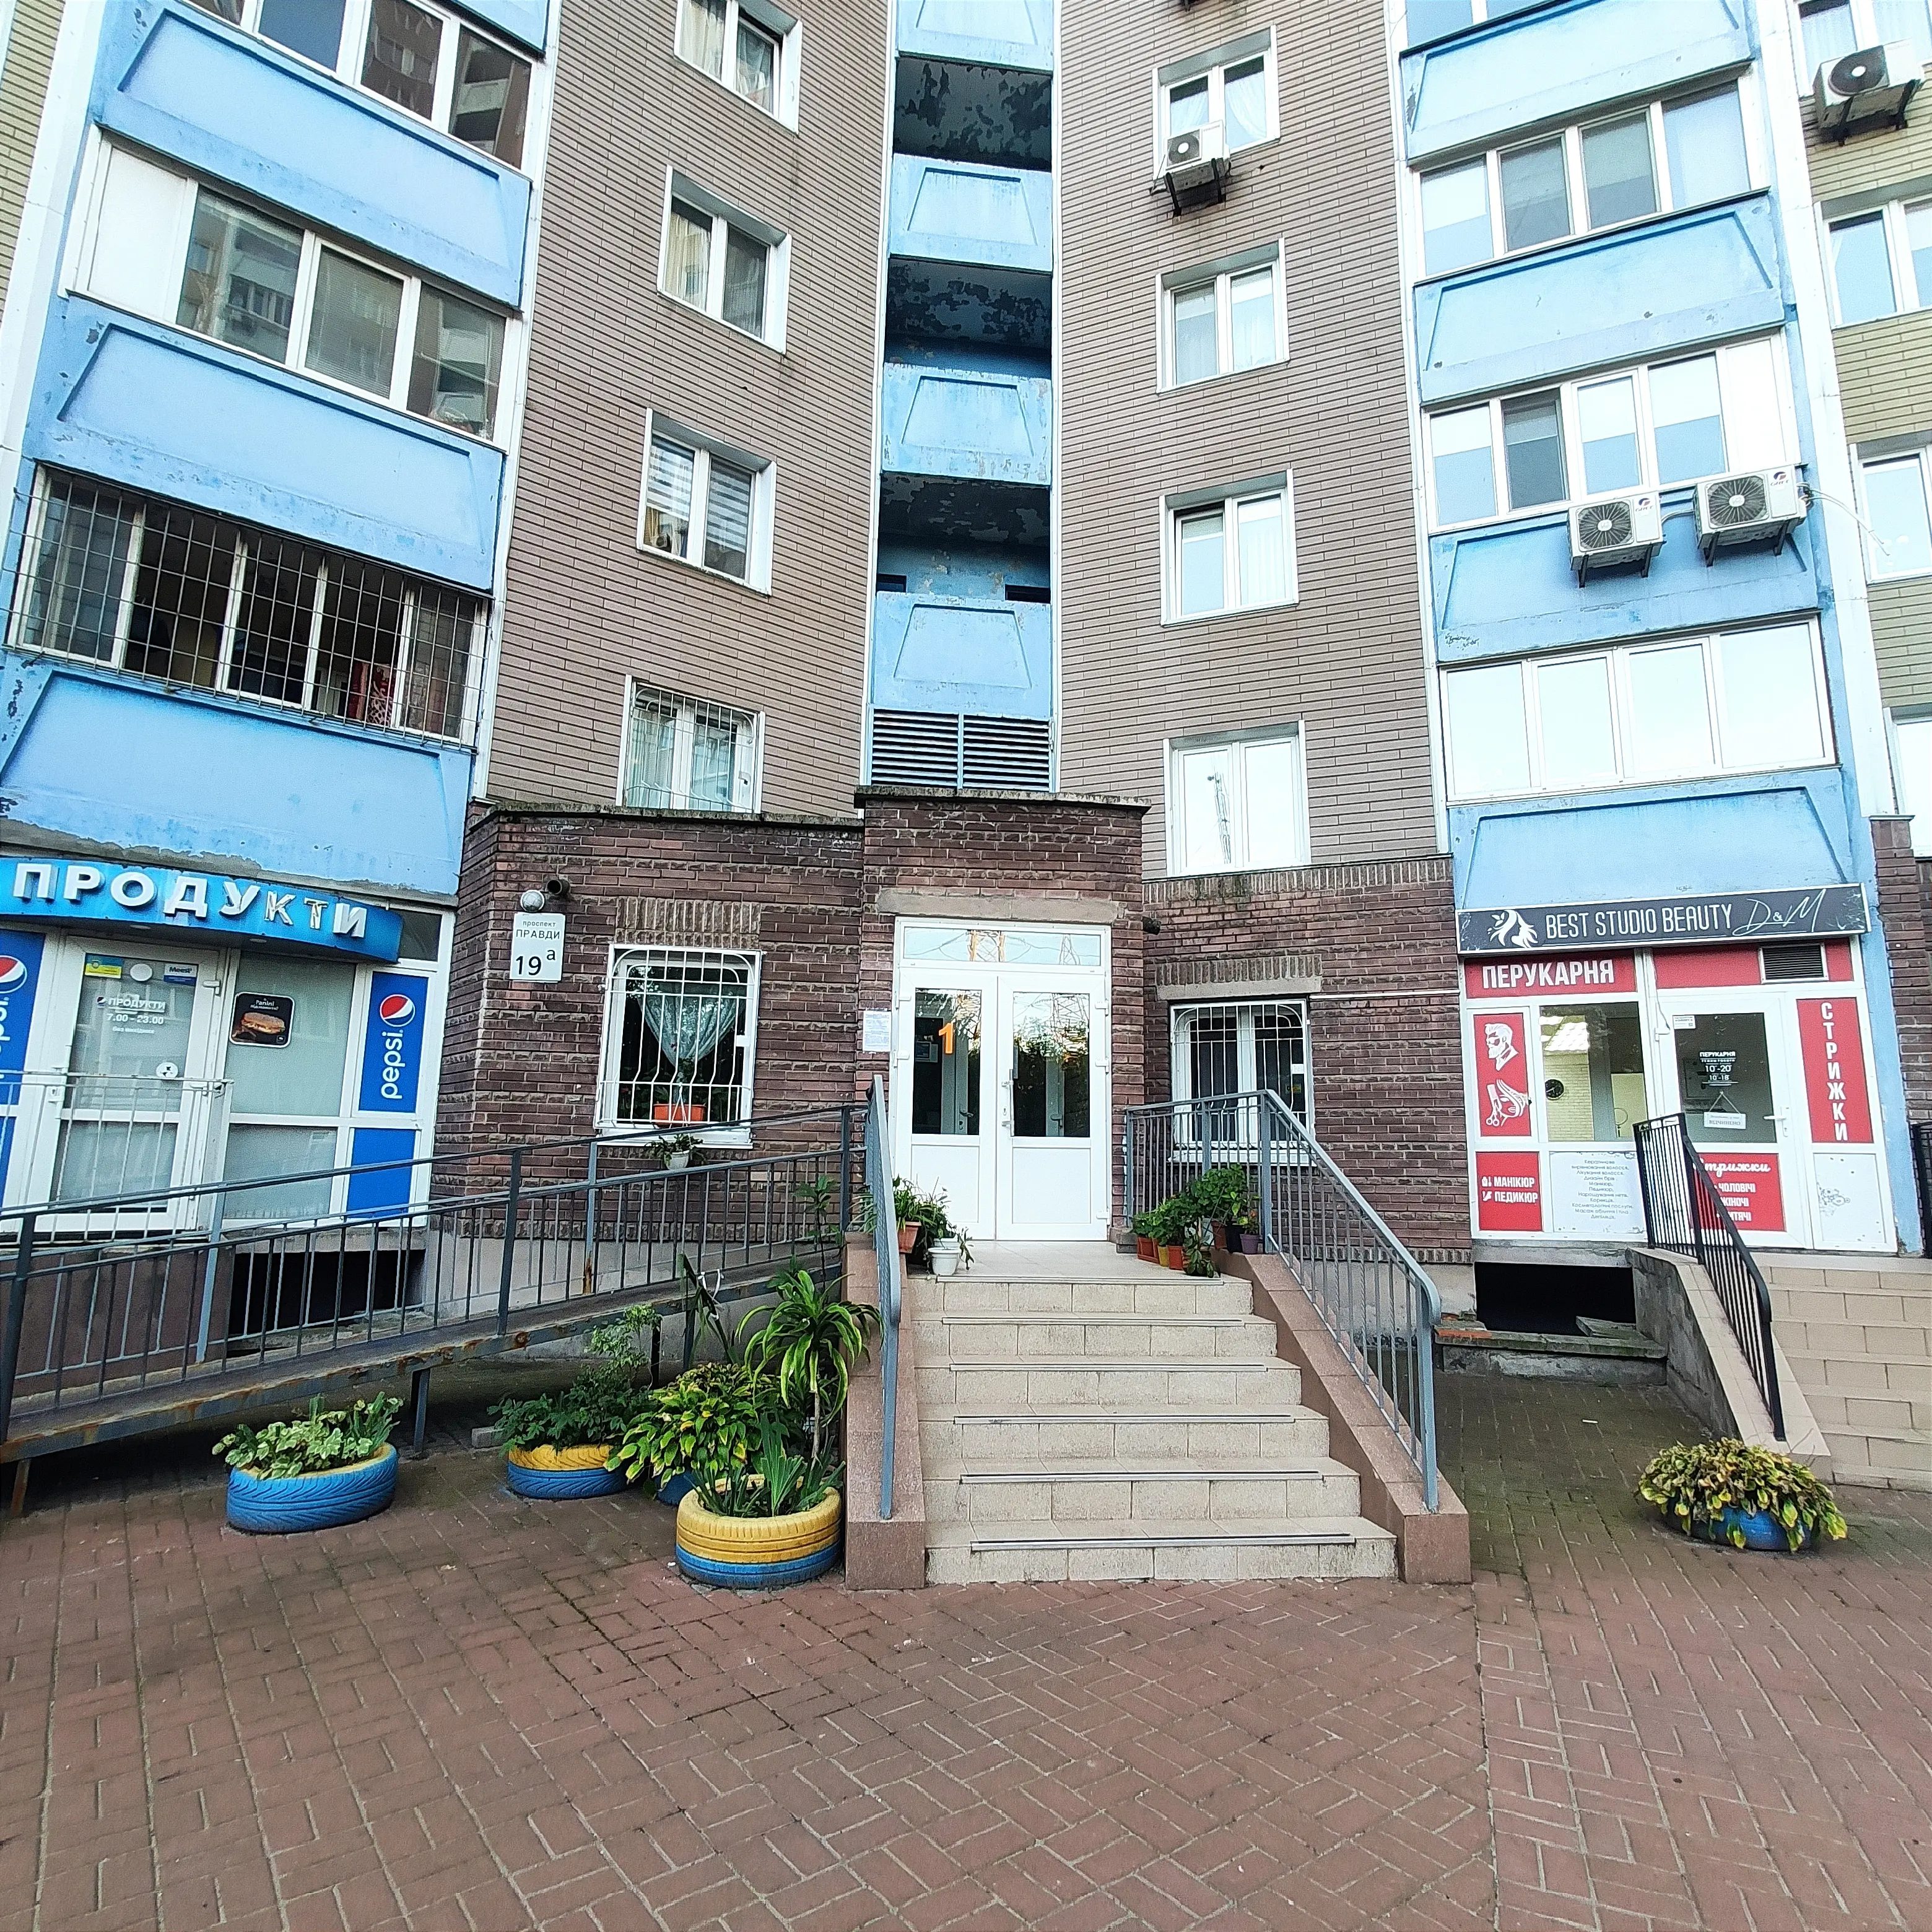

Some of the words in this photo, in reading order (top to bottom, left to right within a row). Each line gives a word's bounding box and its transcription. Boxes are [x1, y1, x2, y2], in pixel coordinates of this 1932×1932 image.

[13, 863, 367, 939] ПРОДУКТИ
[1546, 912, 1589, 939] BEST
[1595, 908, 1657, 936] STUDIO
[1662, 903, 1733, 933] BEAUTY
[516, 929, 560, 940] ПРАВДИ
[1482, 959, 1614, 989] ПЕРУКАРНЯ
[108, 997, 166, 1009] ПРОДУКТИ
[107, 1013, 128, 1022] 7.00
[137, 1014, 164, 1025] 23.00
[938, 1022, 954, 1054] 1
[381, 1030, 406, 1099] pepsi
[1821, 1002, 1848, 1141] СТРИЖКИ
[1494, 1176, 1535, 1188] МАНІКЮР
[1718, 1183, 1756, 1193] ЧОЛОВІЧІ
[1494, 1191, 1538, 1203] ПЕДИКЮР
[1727, 1211, 1752, 1221] ИТЯЧІ
